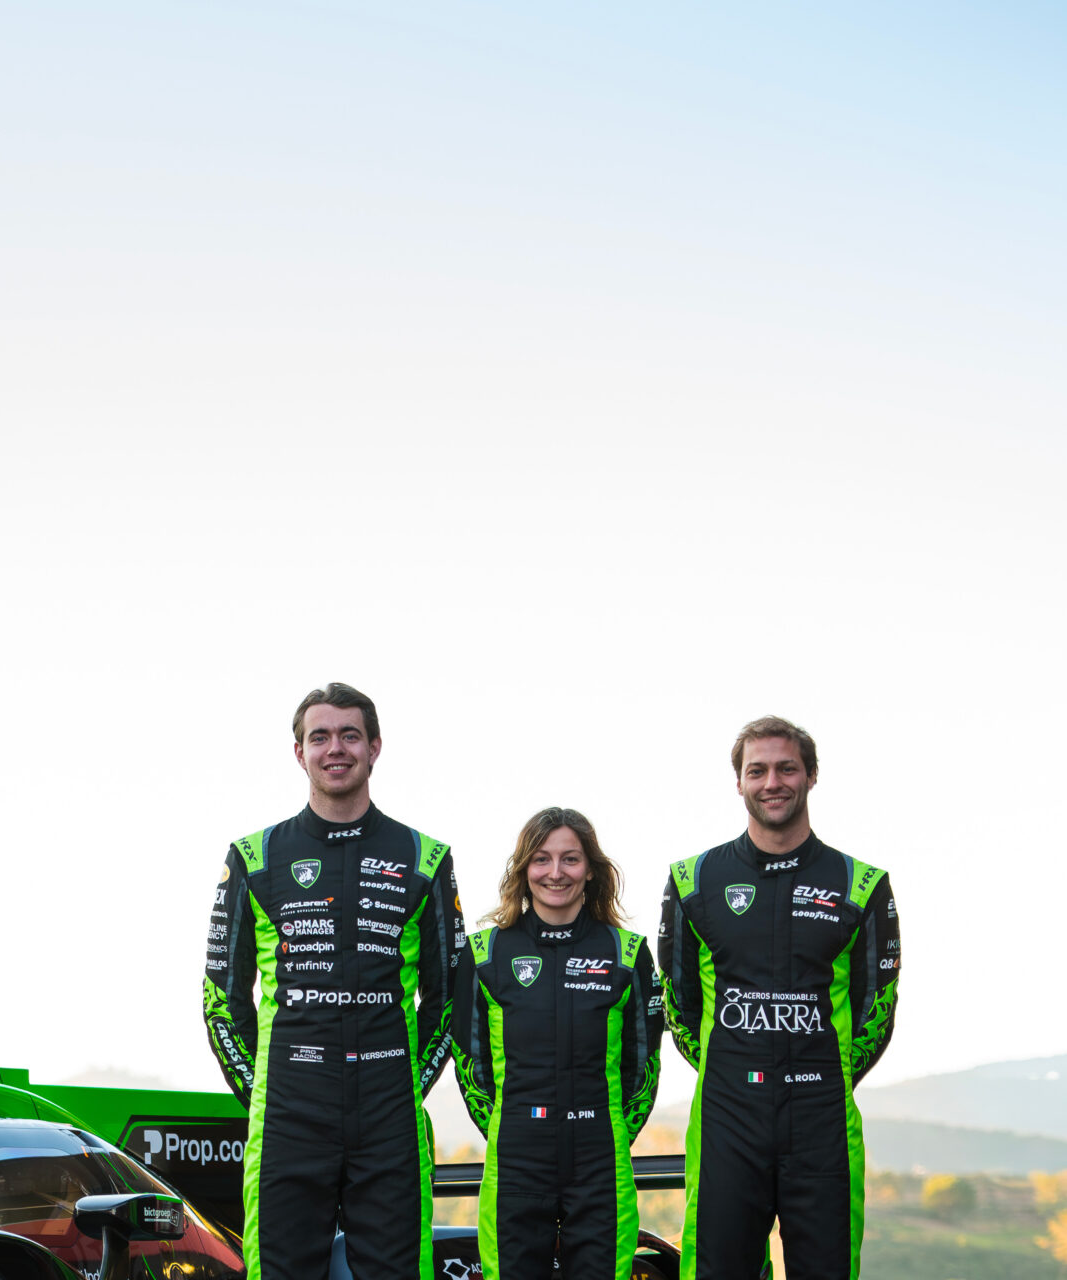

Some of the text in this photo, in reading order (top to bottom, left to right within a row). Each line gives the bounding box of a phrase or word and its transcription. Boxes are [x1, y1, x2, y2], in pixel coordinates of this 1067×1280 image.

[327, 827, 363, 839] HRX
[765, 858, 799, 871] HRX
[858, 867, 879, 892] HRX
[360, 881, 405, 893] GOODYEAR
[281, 900, 328, 910] McLaren
[375, 901, 406, 913] Sorama
[792, 910, 840, 923] GOODYEAR
[294, 919, 334, 929] DMARC
[357, 918, 392, 931] bictgroep
[296, 927, 334, 935] MANAGER
[541, 929, 573, 940] HRX
[289, 940, 334, 953] broadpin
[296, 961, 333, 971] infinity
[564, 982, 612, 992] GOODYEAR
[305, 990, 393, 1006] Prop.com
[742, 992, 818, 1001] ACEROS INOXIDABLES
[217, 1023, 242, 1062] CROSS
[360, 1049, 405, 1061] VERSCHOOR
[784, 1073, 822, 1083] G. RODA
[567, 1110, 595, 1119] D. PIN
